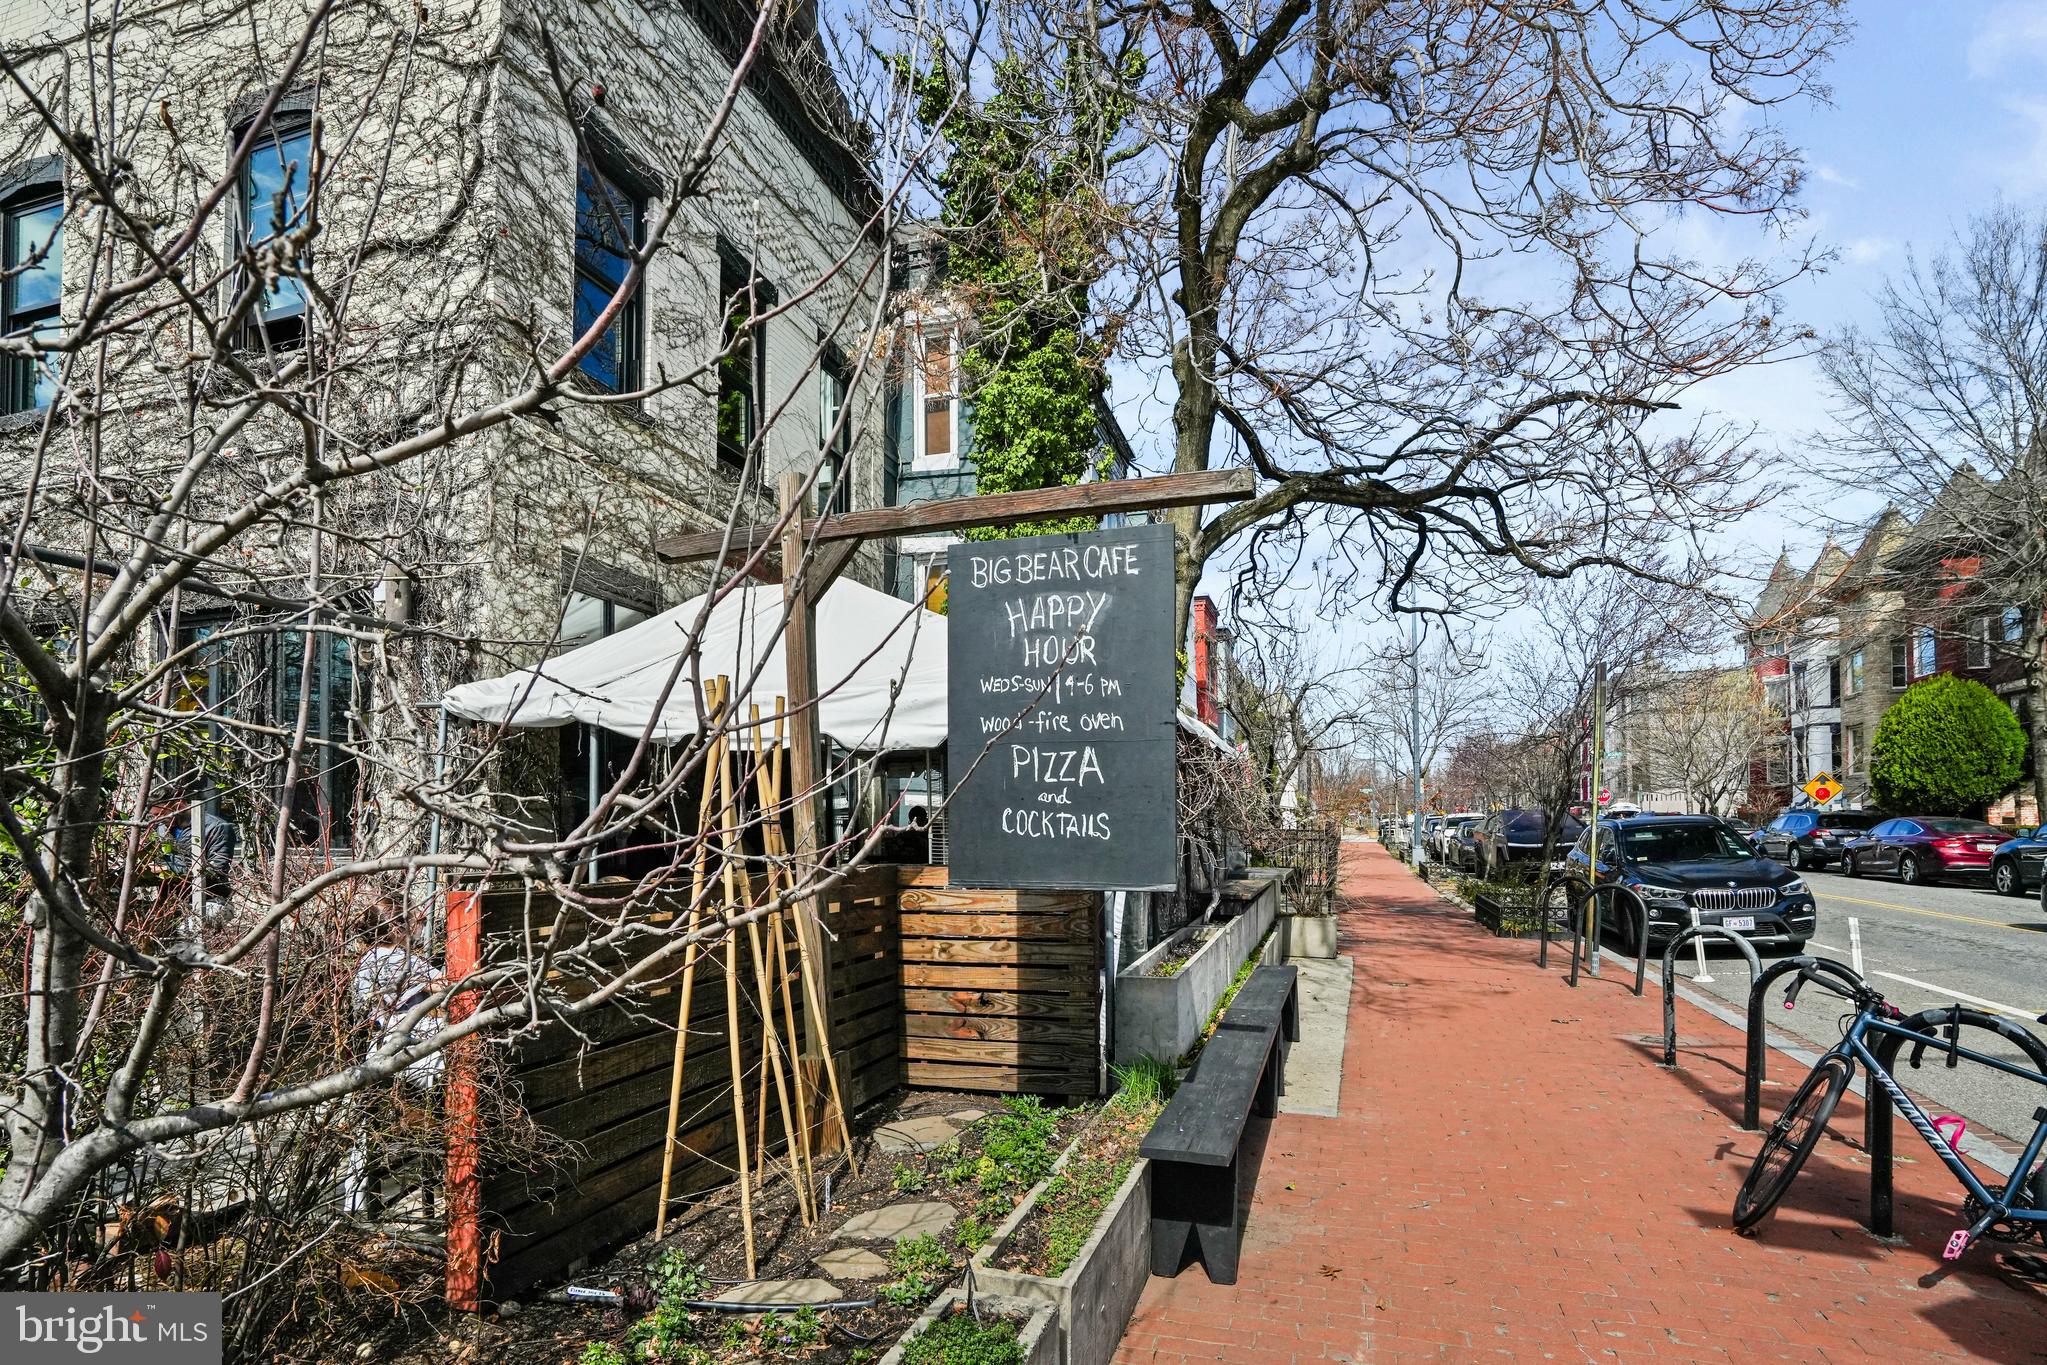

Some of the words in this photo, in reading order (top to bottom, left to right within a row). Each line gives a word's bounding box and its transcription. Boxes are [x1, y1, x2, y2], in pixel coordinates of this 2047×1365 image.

[970, 557, 1012, 588] BIG
[1015, 548, 1081, 584] BEAR
[1083, 544, 1141, 579] CAFE
[1005, 591, 1107, 638] HAPPY
[1024, 635, 1097, 668] HOUR
[1100, 678, 1122, 697] PM
[1080, 711, 1124, 732] oven
[1011, 744, 1105, 787] PIZZA
[1038, 786, 1072, 804] and
[1002, 807, 1111, 840] COCKTAILS
